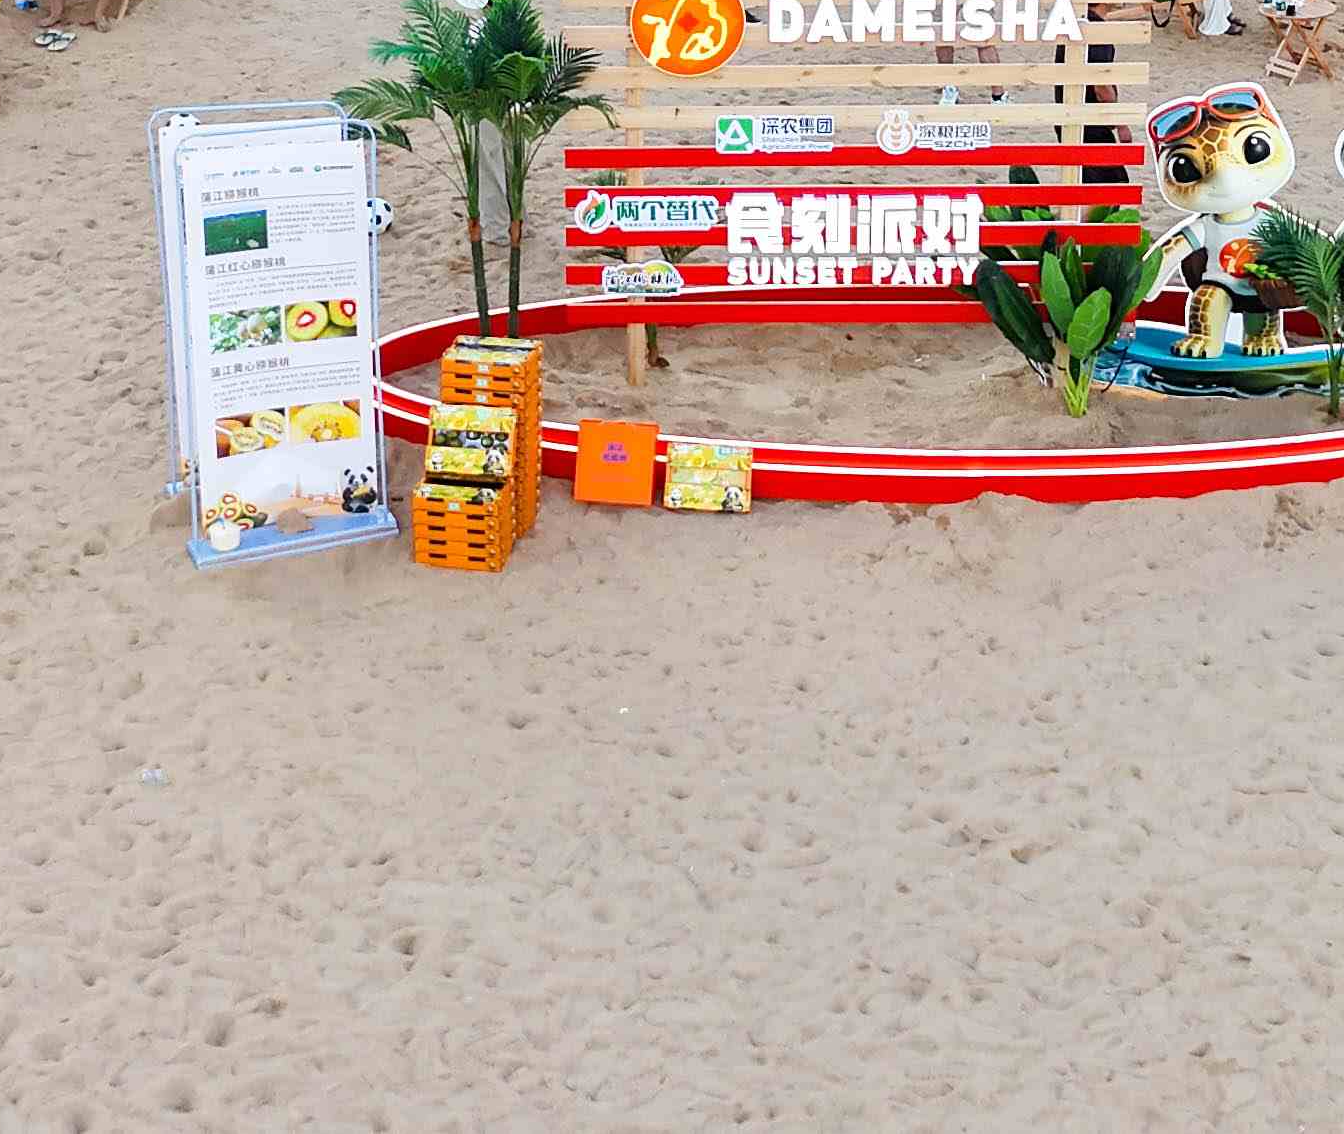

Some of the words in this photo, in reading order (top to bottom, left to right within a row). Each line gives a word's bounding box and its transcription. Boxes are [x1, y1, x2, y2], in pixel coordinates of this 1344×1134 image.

[761, 117, 833, 135] 深农集团
[918, 124, 989, 138] 深粮控股
[616, 200, 715, 221] 两个替代
[725, 192, 984, 254] 食刻派对
[727, 256, 857, 286] SUNSET
[872, 256, 980, 286] PARTY
